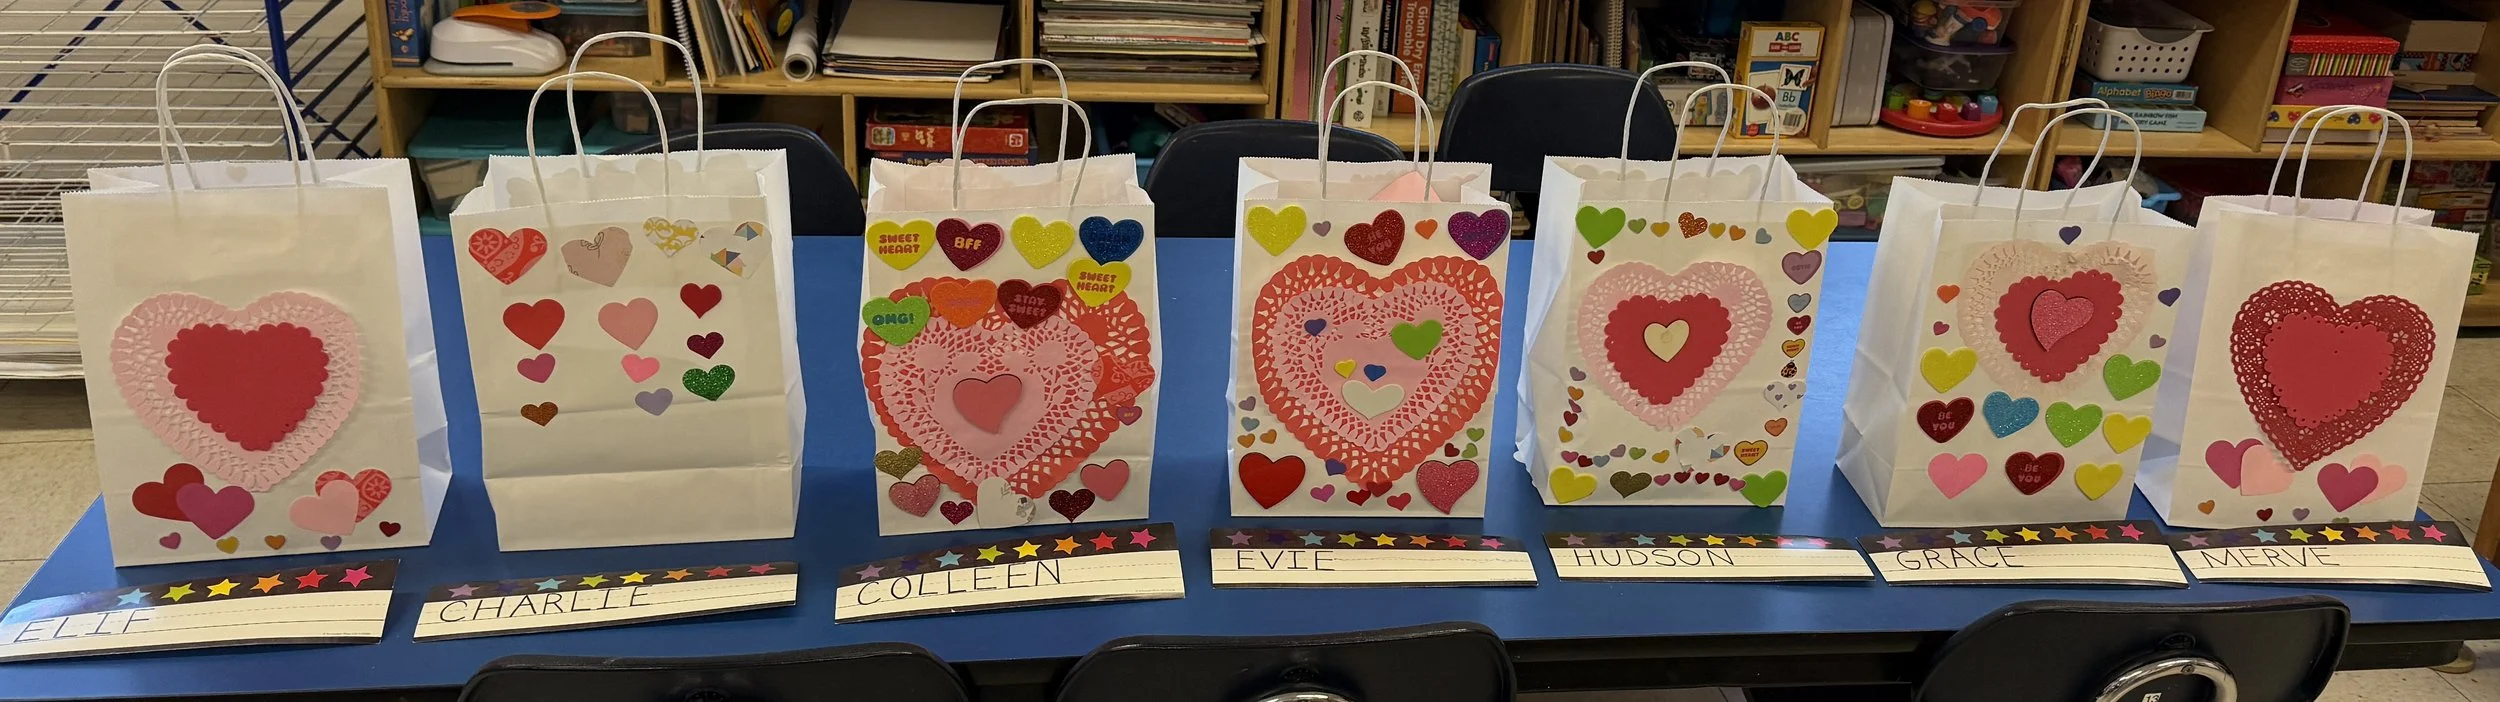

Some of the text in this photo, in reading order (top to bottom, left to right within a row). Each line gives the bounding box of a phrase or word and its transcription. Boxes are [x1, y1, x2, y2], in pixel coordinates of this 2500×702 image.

[1403, 1, 1417, 56] Traceable
[1416, 6, 1428, 37] Giant
[1775, 31, 1800, 41] ABC
[1413, 41, 1425, 60] Dry
[1782, 91, 1796, 102] Bb
[2097, 86, 2173, 98] Alphabet Bingo
[878, 233, 920, 244] SWEET
[954, 236, 982, 250] BFF
[878, 244, 920, 254] HEART
[1367, 239, 1392, 255] YOU
[1079, 271, 1117, 283] SWEET
[1076, 281, 1115, 294] HEART
[1013, 293, 1046, 306] STAY
[1008, 304, 1047, 317] SWEET
[872, 312, 915, 326] OMG!
[1932, 421, 1955, 431] YOU
[2018, 474, 2041, 483] YOU
[1237, 550, 1336, 571] EVIE
[1573, 549, 1735, 567] HUDSON
[1896, 546, 2024, 570] GRACE
[2200, 547, 2340, 568] MERVE
[857, 559, 1061, 605] COLLEEN
[440, 585, 653, 623] CHARLIE
[14, 608, 156, 643] ELIF
